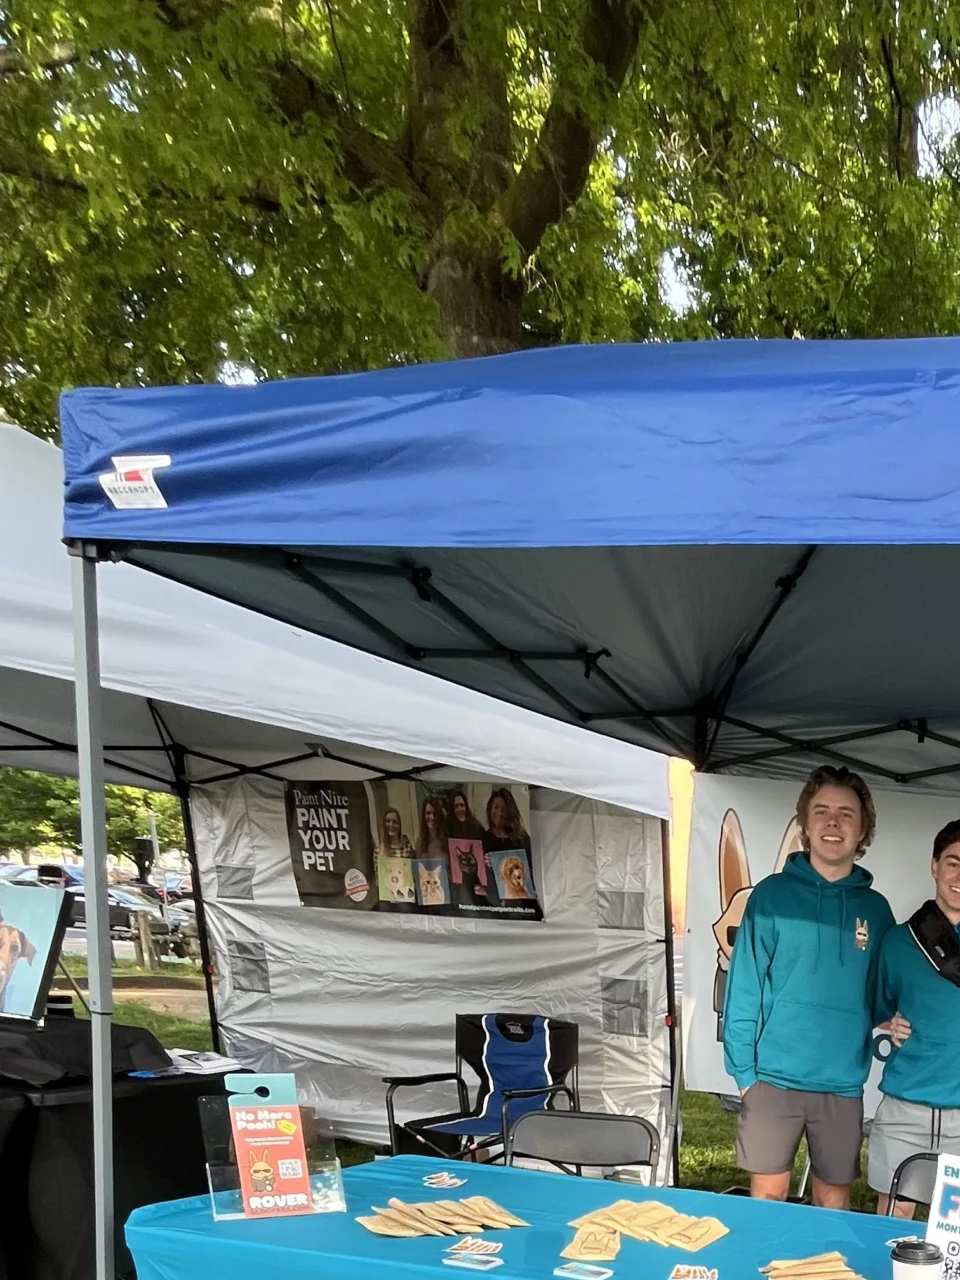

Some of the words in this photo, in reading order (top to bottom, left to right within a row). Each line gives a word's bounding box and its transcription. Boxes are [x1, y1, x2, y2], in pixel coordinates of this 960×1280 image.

[293, 789, 319, 805] Paint
[320, 789, 349, 806] Nite
[296, 808, 349, 829] PAINT
[298, 829, 350, 851] YOUR
[302, 851, 334, 871] PET
[235, 1111, 255, 1121] No
[257, 1110, 293, 1121] More
[249, 1193, 308, 1209] ROVER
